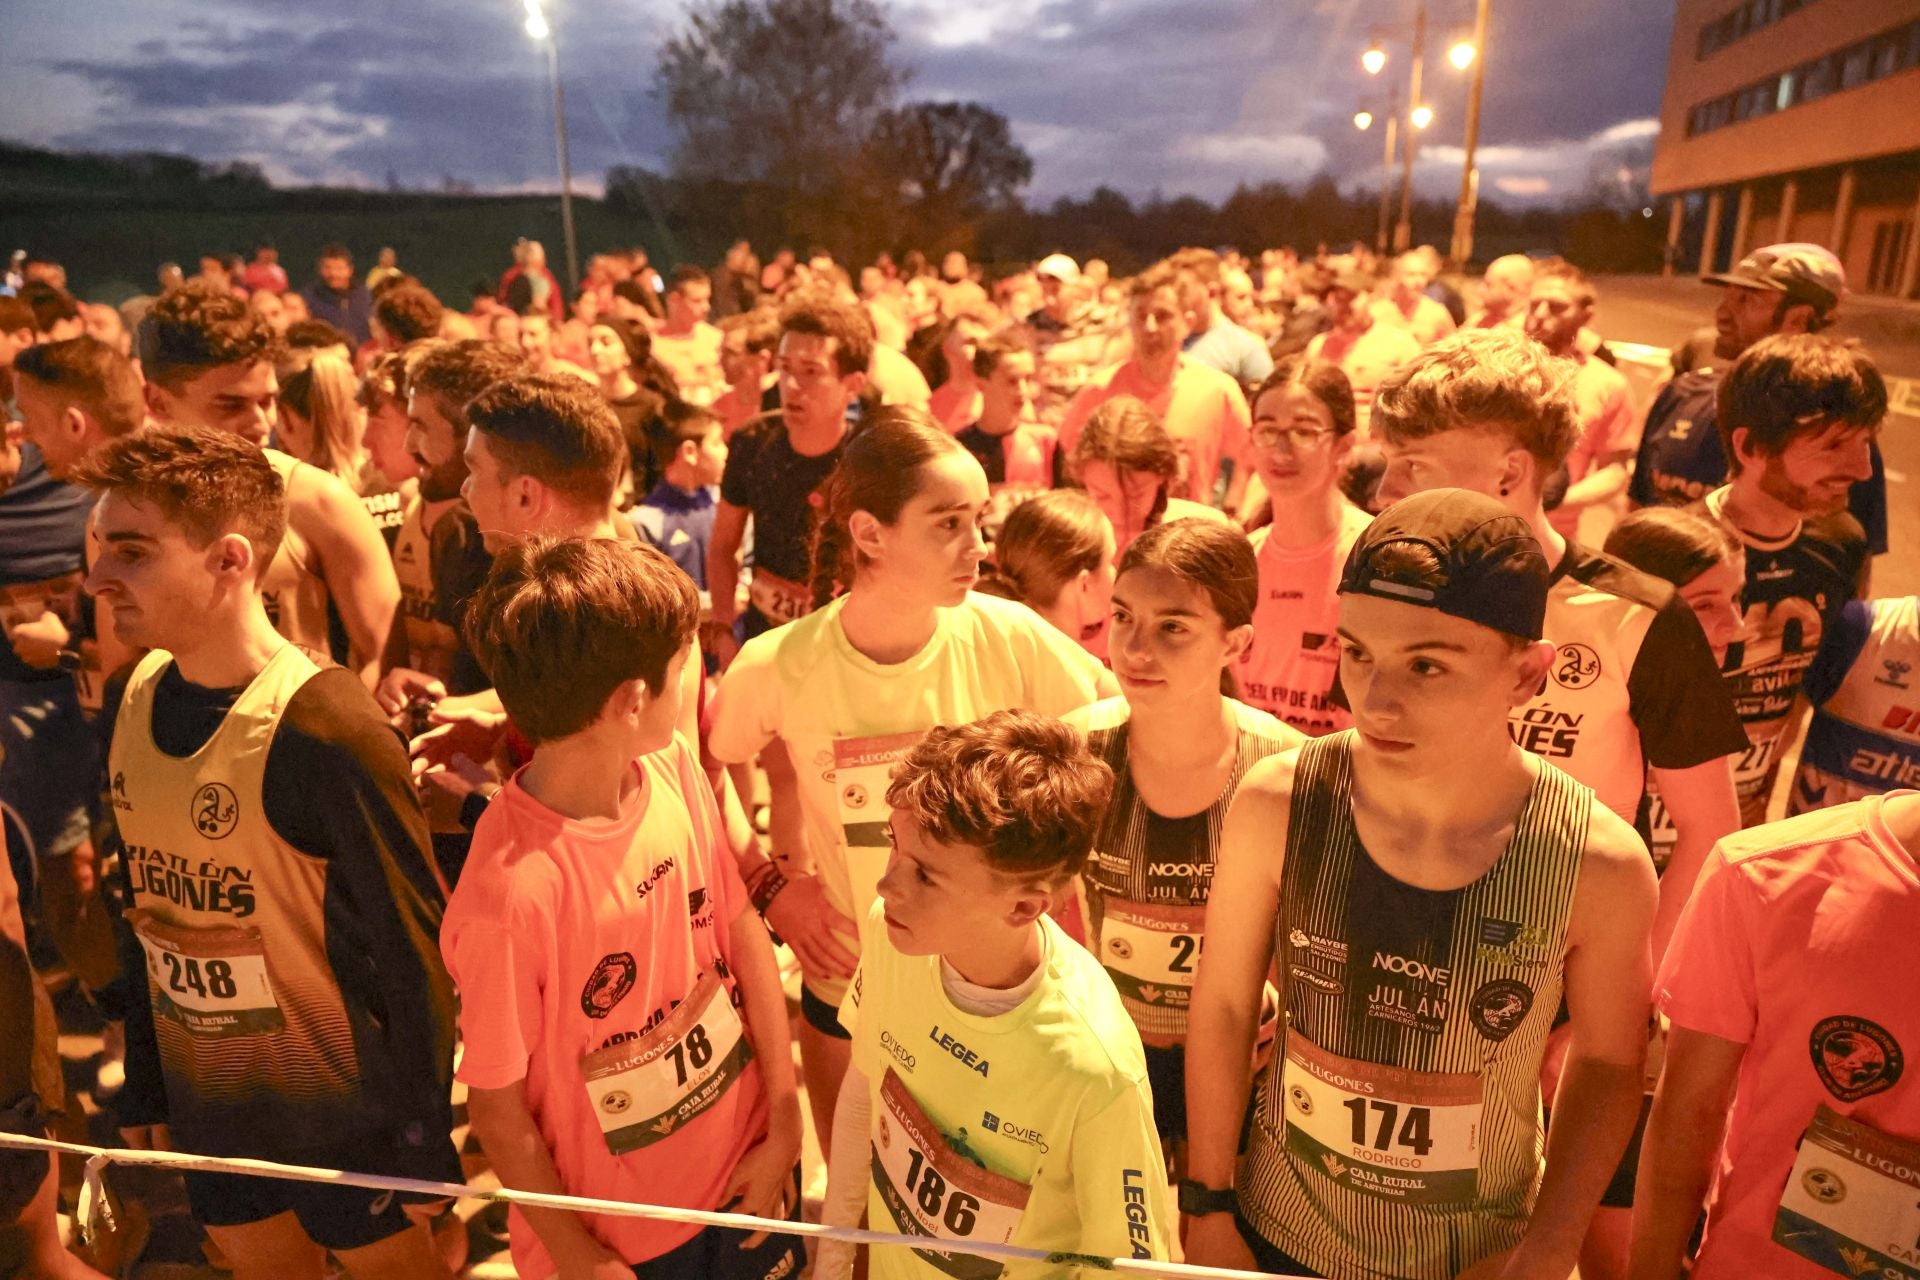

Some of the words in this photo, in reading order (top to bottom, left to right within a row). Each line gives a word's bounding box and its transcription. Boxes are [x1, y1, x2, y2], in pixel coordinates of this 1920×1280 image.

[125, 844, 252, 883] RIATLÓN
[1148, 862, 1215, 877] NOONE
[132, 862, 256, 918] UGONES
[1132, 915, 1189, 931] LUGONES
[1168, 934, 1204, 973] 2
[1311, 935, 1348, 951] MAYBE
[162, 952, 238, 999] 248
[1372, 952, 1451, 986] NOONE
[1368, 1009, 1418, 1028] CARNICEROS
[1420, 1022, 1441, 1032] 1962
[1369, 1003, 1416, 1020] ARTESANOS
[614, 1034, 675, 1071] LUGONES
[664, 1023, 713, 1088] 78
[881, 1031, 916, 1068] OVIEDO
[929, 1025, 990, 1078] LEGEA
[678, 1095, 702, 1115] CAJA
[701, 1070, 727, 1099] RURAL
[1309, 1062, 1375, 1094] LUGONES
[894, 1105, 937, 1162] LUGONES
[1343, 1097, 1433, 1156] 174
[1352, 1146, 1422, 1169] RODRIGO
[904, 1147, 981, 1237] 186
[1350, 1167, 1379, 1182] CAJA
[1382, 1174, 1426, 1189] RURAL
[915, 1207, 939, 1234] Noel
[1122, 1168, 1152, 1260] LEGEA
